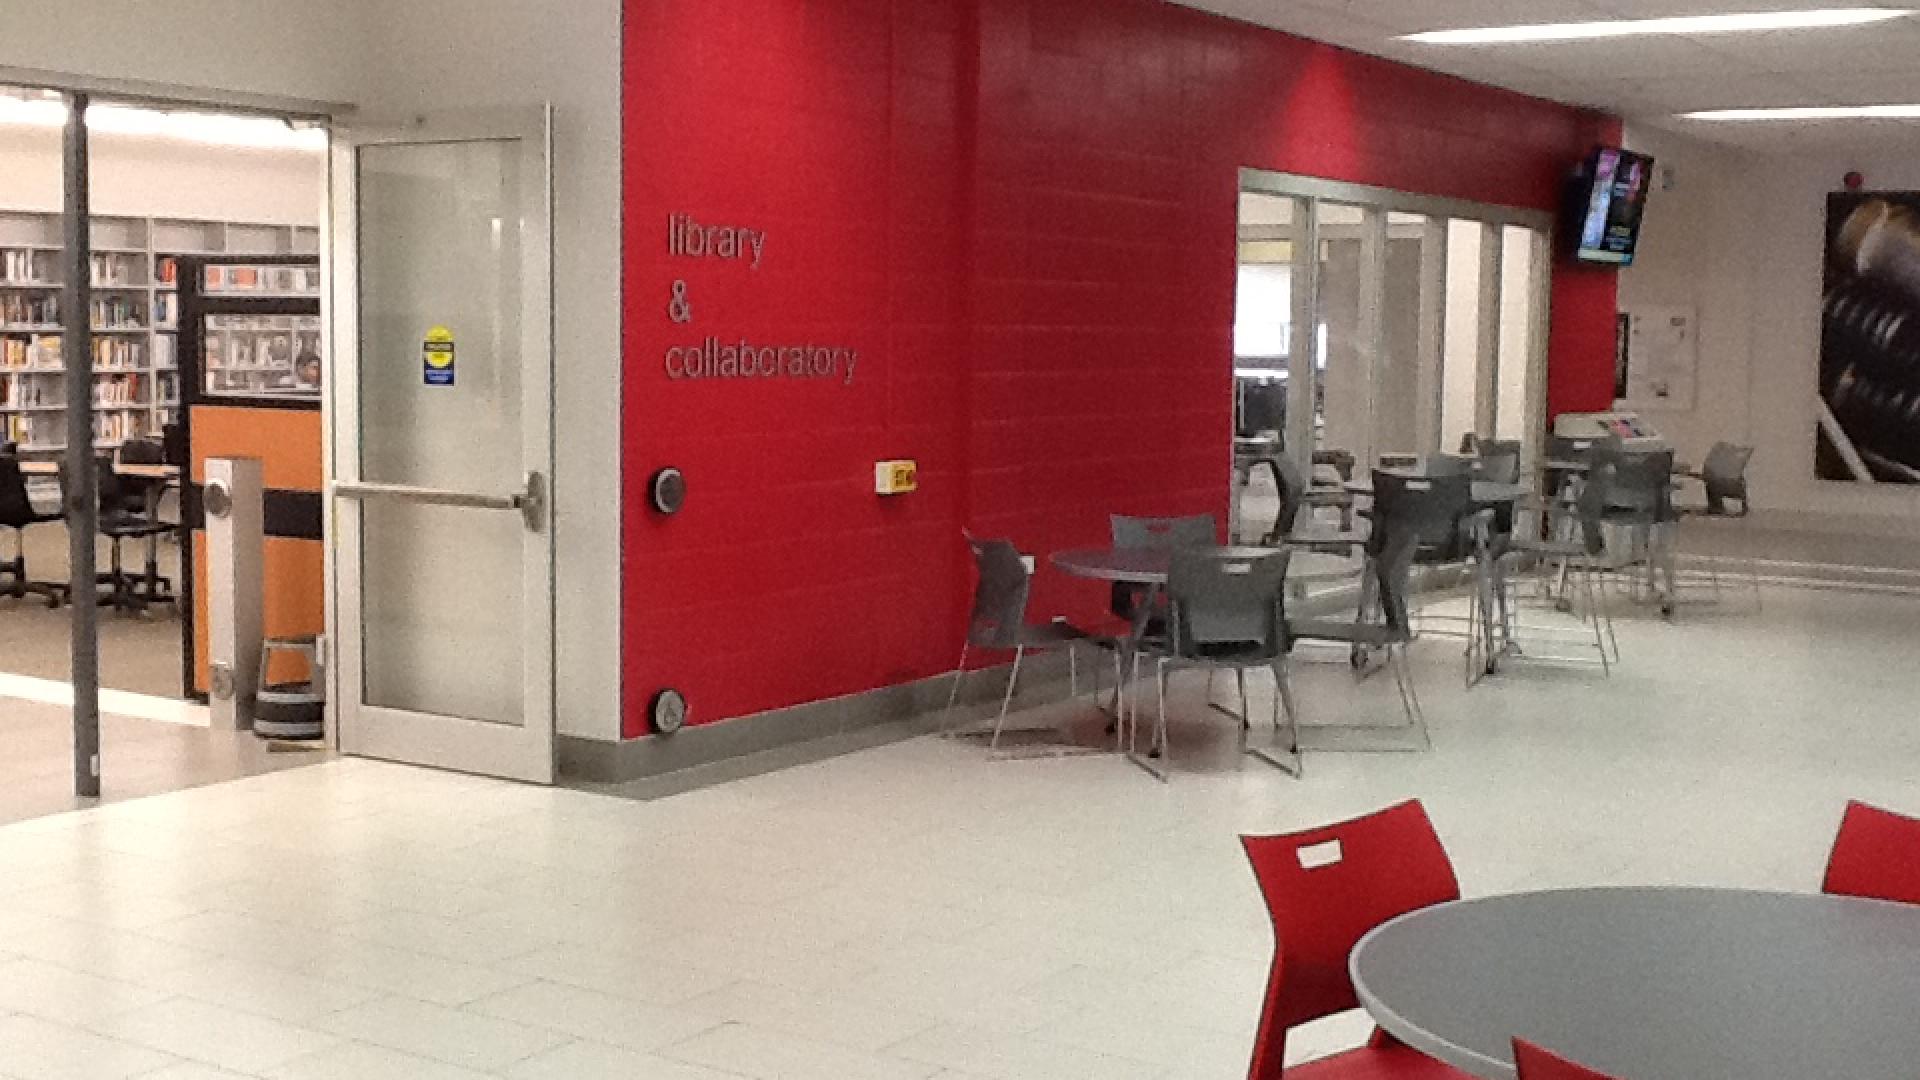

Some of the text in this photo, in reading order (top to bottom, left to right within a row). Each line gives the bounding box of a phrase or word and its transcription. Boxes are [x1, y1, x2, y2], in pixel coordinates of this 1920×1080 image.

[667, 212, 766, 270] library
[668, 279, 691, 323] &
[664, 335, 858, 385] collaboratory
